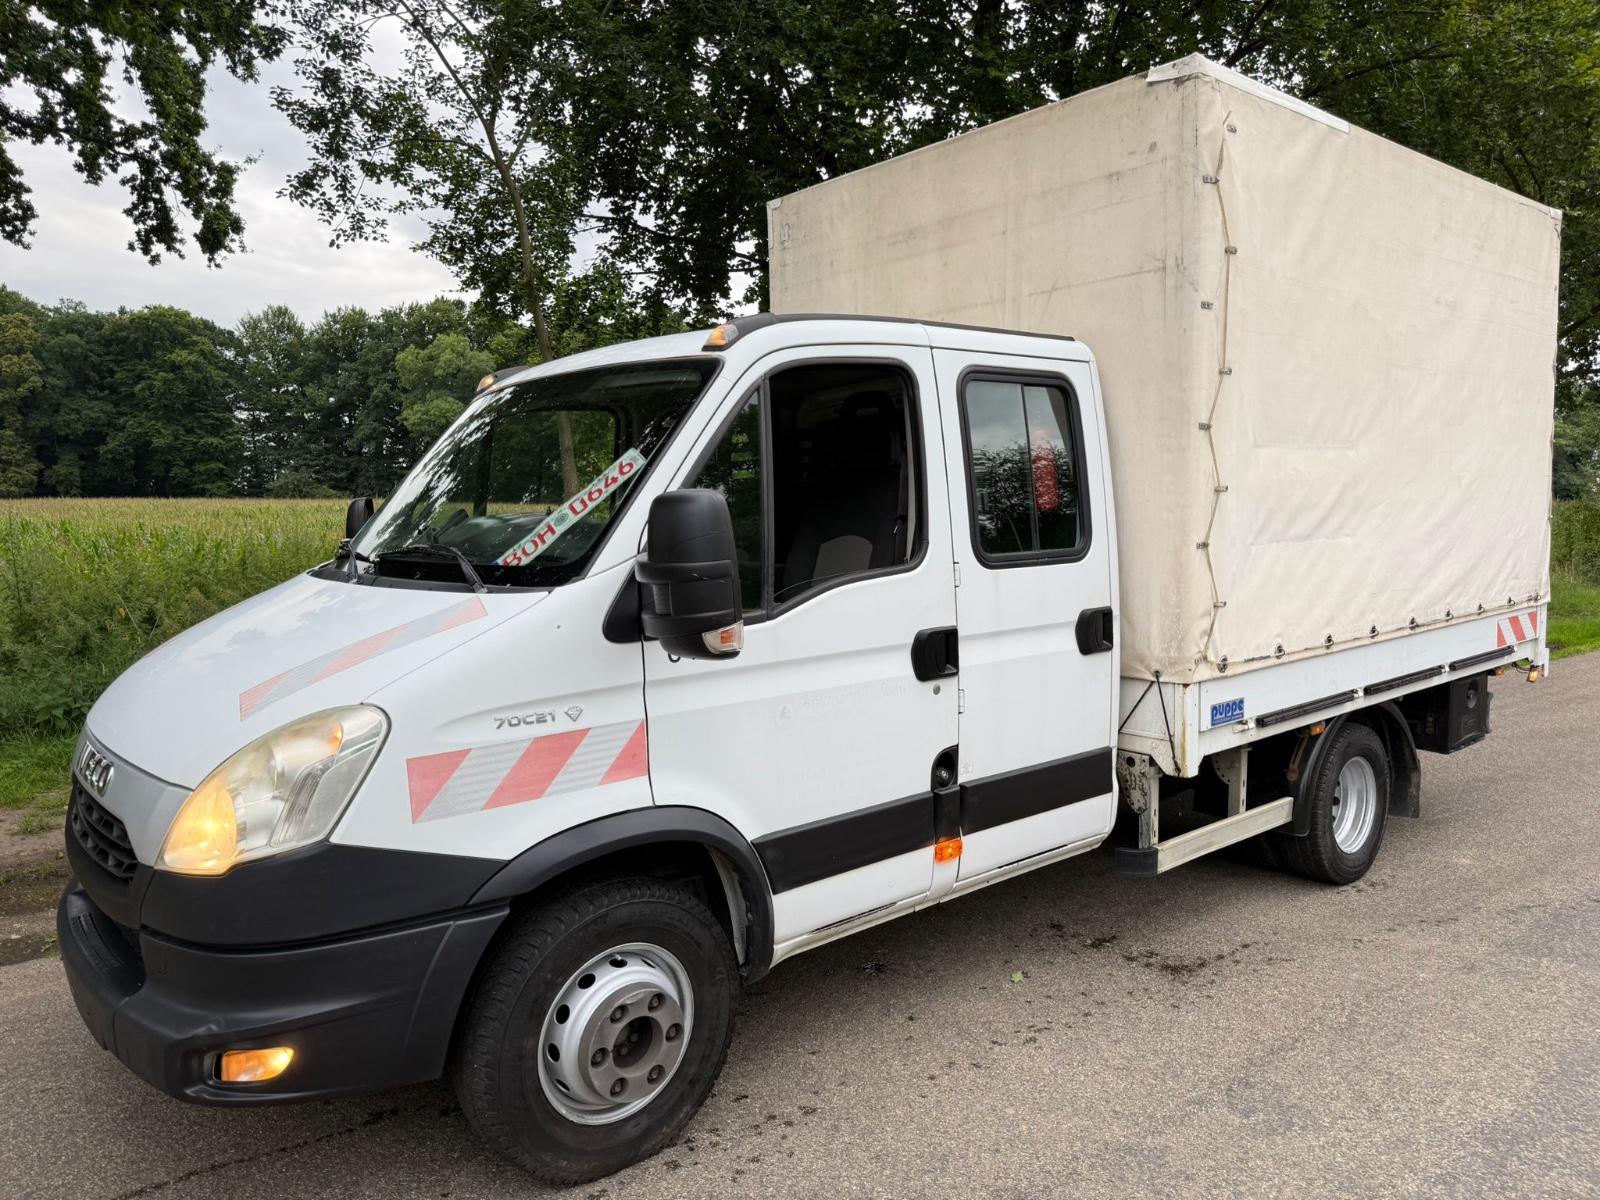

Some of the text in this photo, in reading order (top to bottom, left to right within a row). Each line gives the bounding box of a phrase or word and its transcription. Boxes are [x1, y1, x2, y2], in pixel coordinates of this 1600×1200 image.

[502, 460, 635, 567] BOH 0646
[494, 710, 556, 730] 70C21
